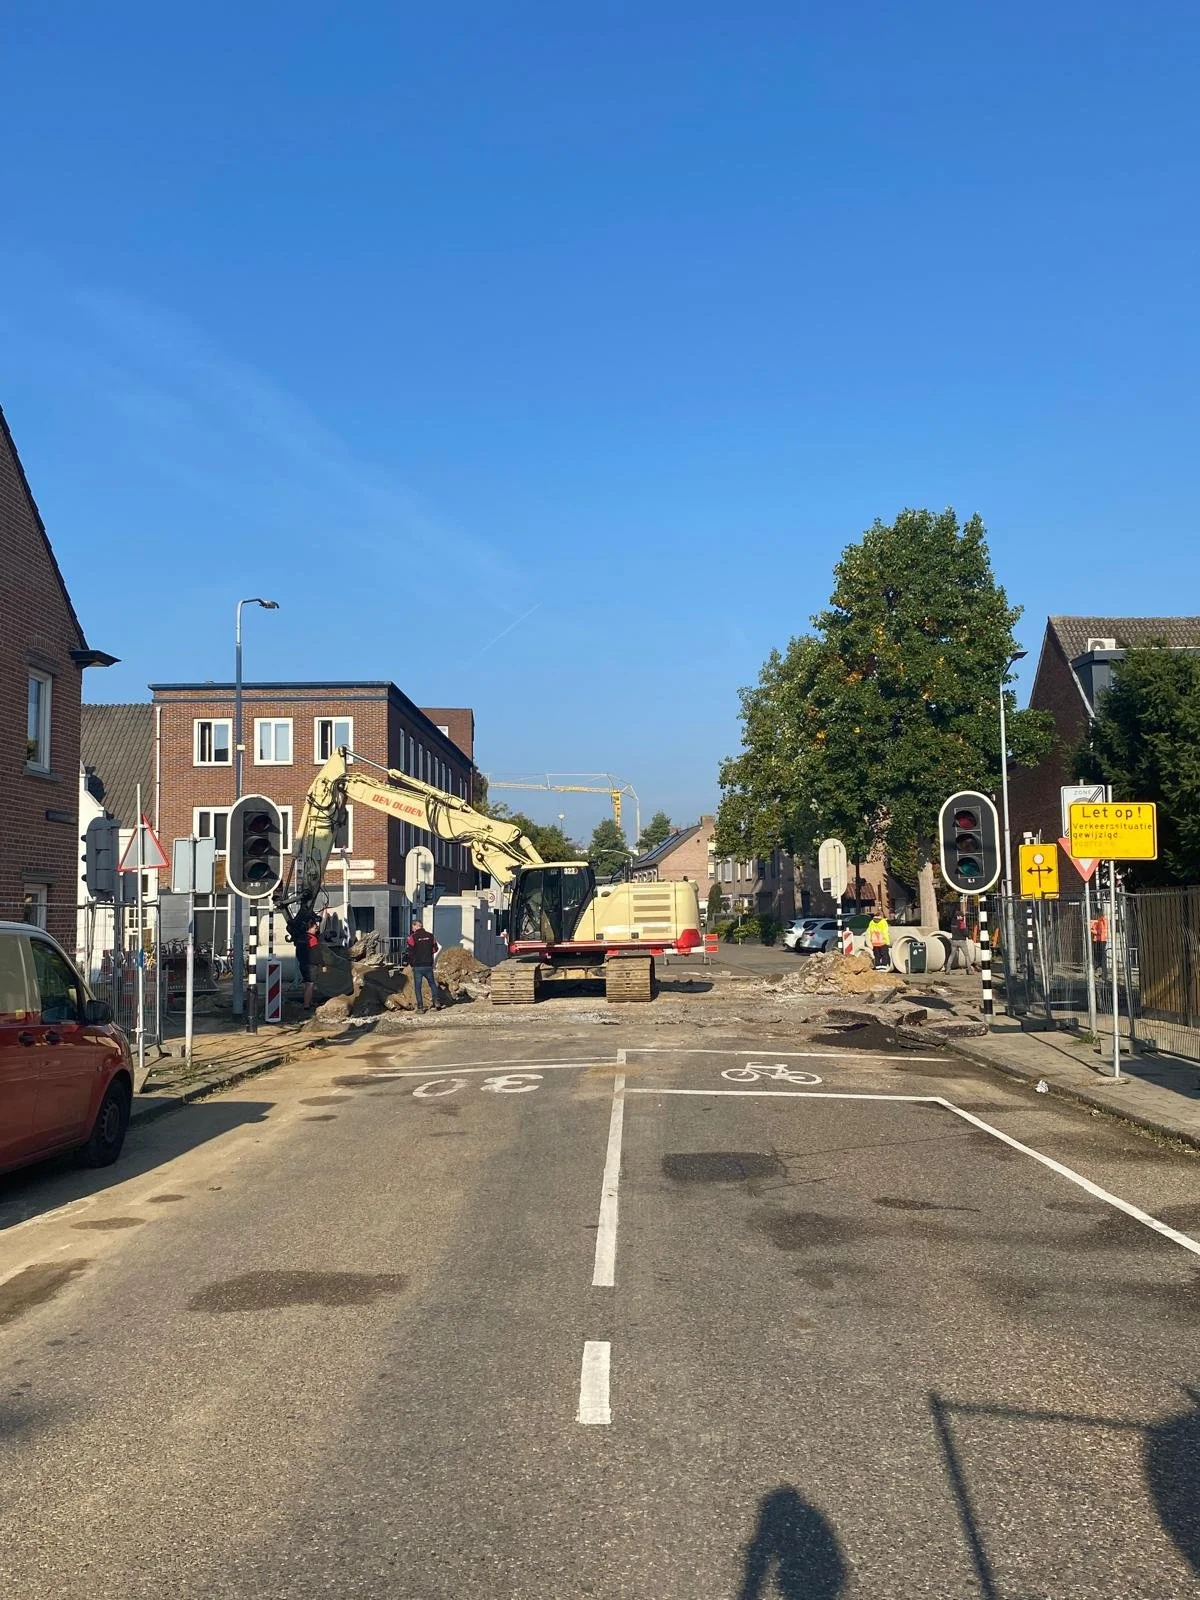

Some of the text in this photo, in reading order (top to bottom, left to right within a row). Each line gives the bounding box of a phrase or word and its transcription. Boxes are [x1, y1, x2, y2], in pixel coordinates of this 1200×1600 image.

[372, 794, 424, 817] DEN OUDEN
[1082, 807, 1108, 818] Let
